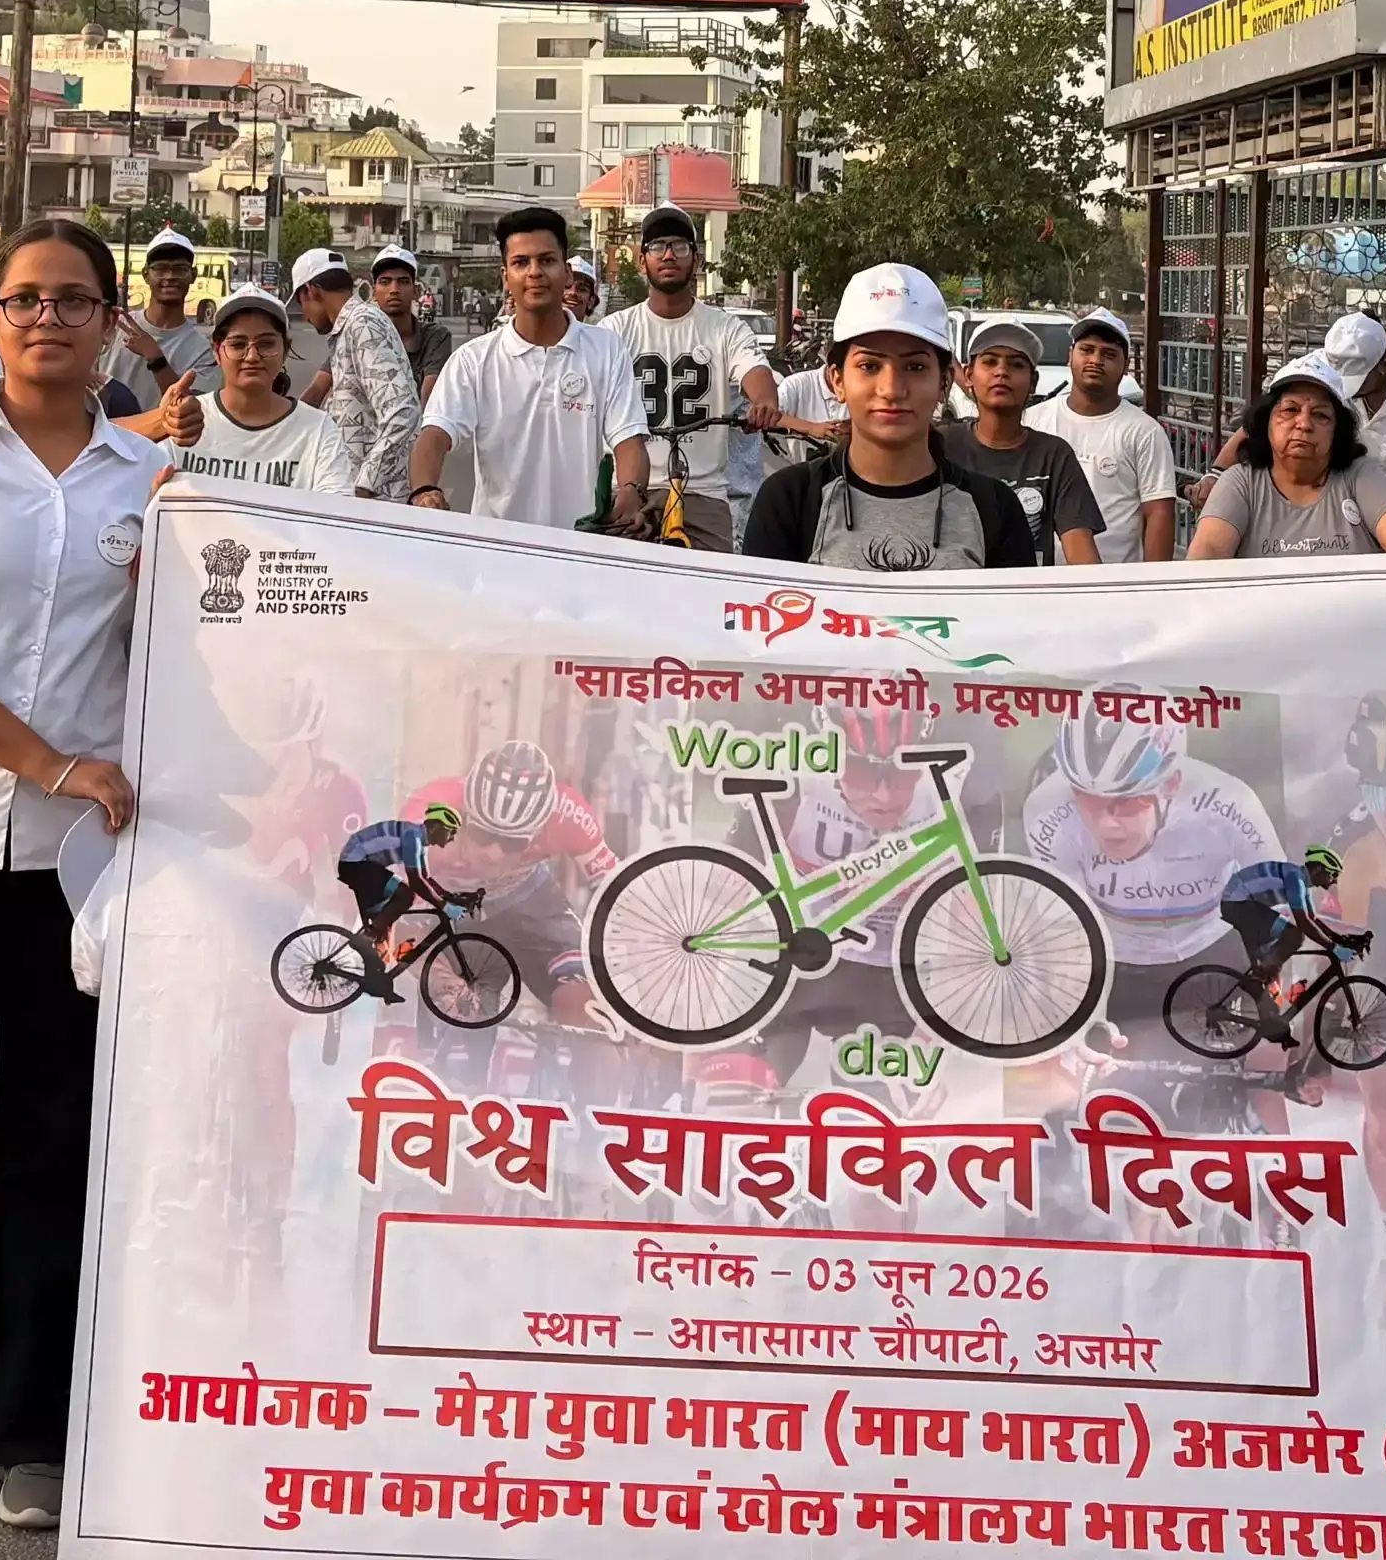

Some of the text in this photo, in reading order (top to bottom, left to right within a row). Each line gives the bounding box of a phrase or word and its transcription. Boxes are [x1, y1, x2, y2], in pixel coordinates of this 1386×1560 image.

[1134, 33, 1159, 81] A.S.
[124, 161, 138, 171] BR
[632, 351, 713, 432] 32
[258, 562, 328, 575] एवं खेल मंत्रालय
[259, 551, 276, 562] युवा
[256, 589, 369, 602] YOUTH AFFAIRS
[257, 577, 334, 588] MINISTRY OF
[255, 602, 347, 615] AND SPORTS
[822, 606, 960, 641] भारत
[553, 656, 1242, 731] "साइकिल अपनाओ, प्रदूषण घटाओ"
[667, 721, 841, 774] World
[840, 838, 910, 882] bicycle
[1124, 876, 1220, 901] sdworx
[838, 1031, 942, 1087] day
[349, 1062, 1358, 1229] विश्व साइकिल दिवस
[634, 1241, 754, 1289] दिनांक
[806, 1258, 857, 1292] 03
[867, 1260, 934, 1310] जून
[949, 1264, 1050, 1303] 2026
[522, 1311, 620, 1351] स्थान
[671, 1316, 856, 1361] आनासागर
[873, 1309, 1020, 1375] चौपाटी,
[1033, 1327, 1162, 1374] अजमेर
[139, 1361, 372, 1430] आयोजक
[435, 1372, 537, 1440] मेरा
[546, 1392, 656, 1461] युवा
[666, 1398, 809, 1453] भारत
[824, 1389, 970, 1467] (माय
[980, 1402, 1152, 1479] भारत)
[1171, 1409, 1365, 1476] अजमेर
[263, 1465, 373, 1531] युवा
[380, 1461, 611, 1531] कार्यक्रम
[619, 1469, 713, 1531] एवं
[716, 1471, 843, 1537] खेल
[853, 1477, 1072, 1546] मंत्रालय
[1084, 1502, 1229, 1555] भारत
